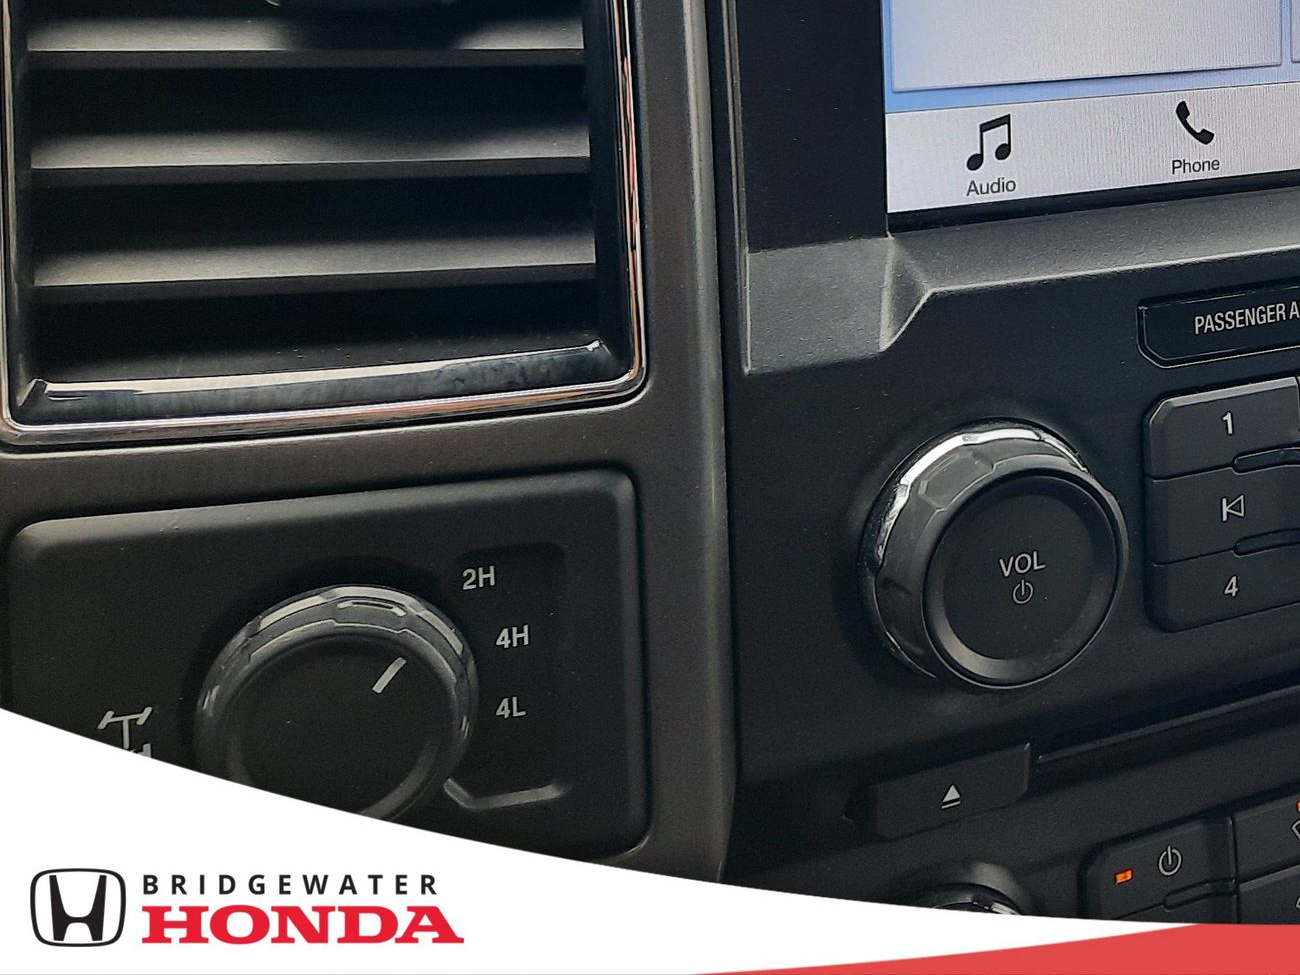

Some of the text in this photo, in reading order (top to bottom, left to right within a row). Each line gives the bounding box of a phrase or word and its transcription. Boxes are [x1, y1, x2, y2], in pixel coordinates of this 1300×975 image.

[1171, 157, 1220, 175] Phone
[966, 176, 1017, 197] Audio
[1194, 303, 1286, 335] PASSENGER
[1222, 411, 1234, 435] 1
[999, 551, 1046, 577] VOL
[461, 566, 496, 590] 2H
[1224, 575, 1239, 598] 4
[495, 625, 530, 649] 4H
[495, 696, 526, 719] 4L
